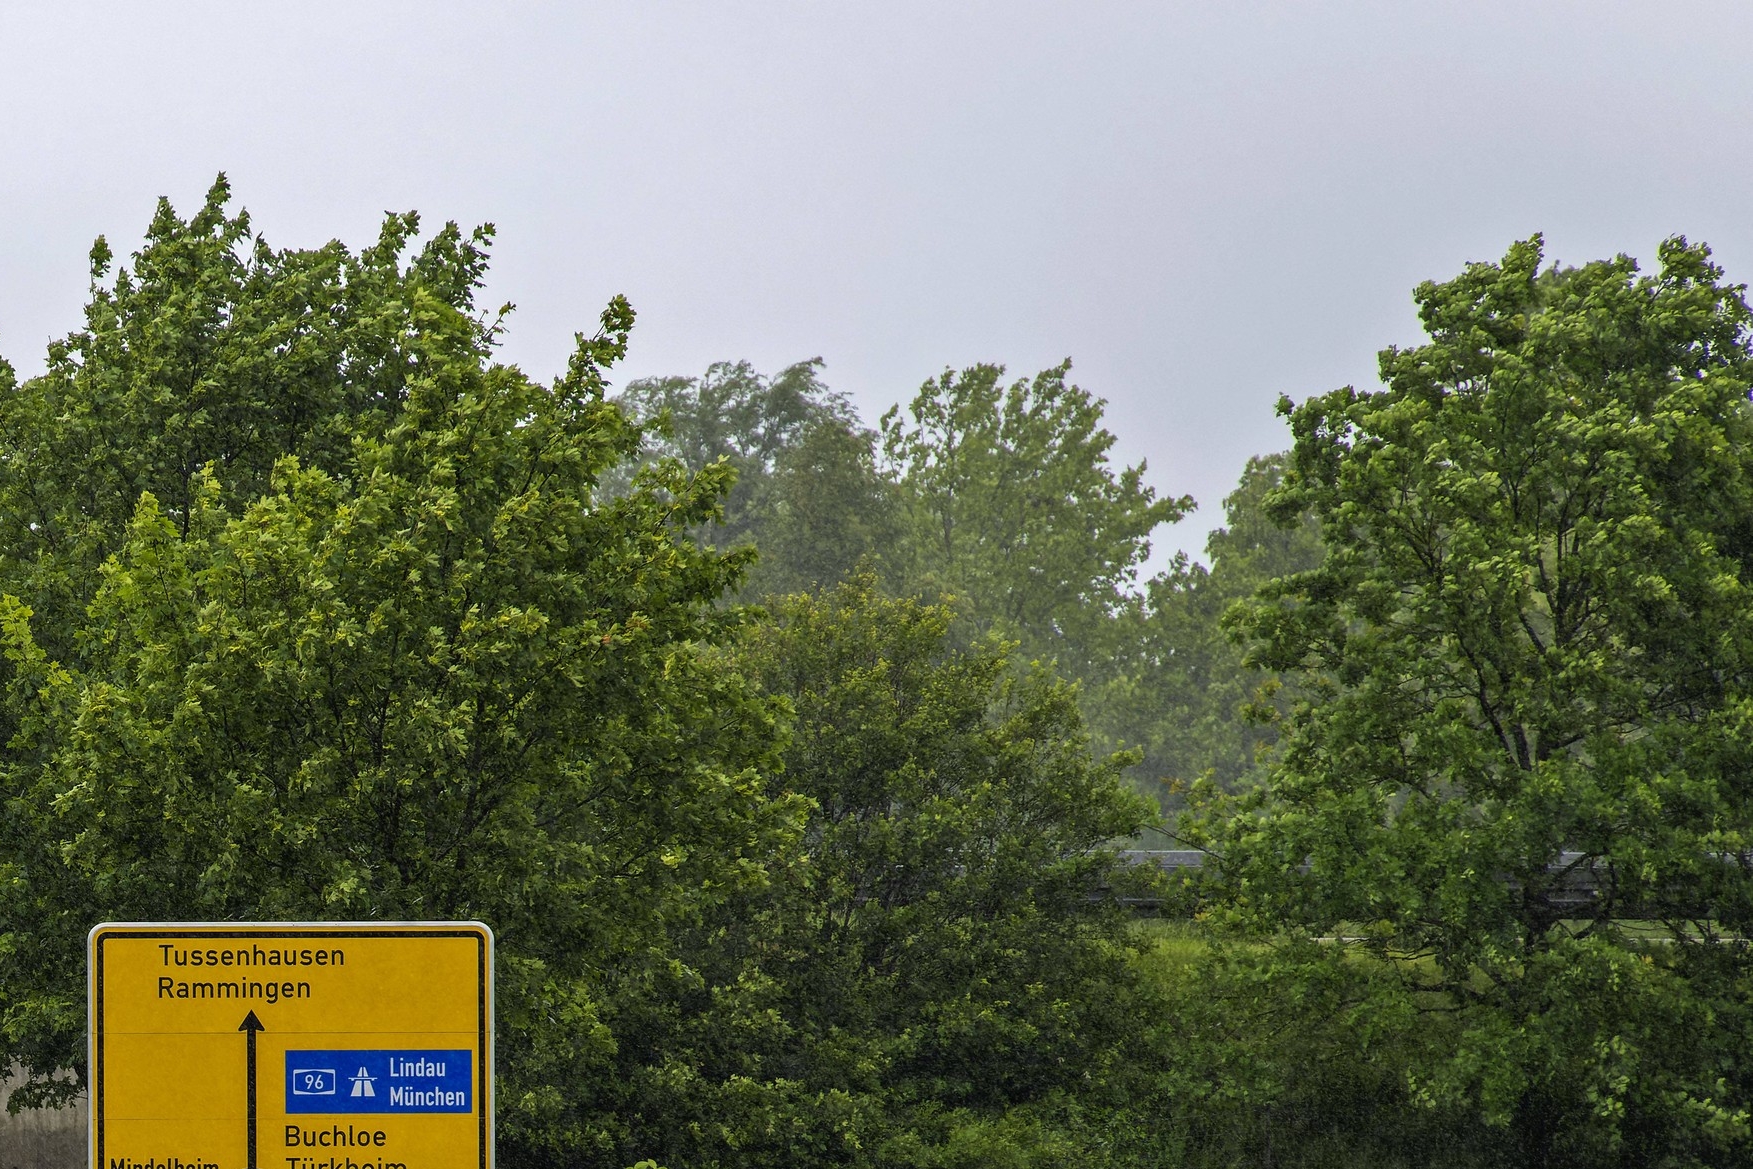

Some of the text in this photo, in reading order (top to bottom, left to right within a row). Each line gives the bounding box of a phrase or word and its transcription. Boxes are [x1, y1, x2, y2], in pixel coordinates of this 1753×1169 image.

[158, 943, 345, 967] Tussenhausen
[158, 976, 311, 1004] Rammingen
[389, 1057, 446, 1077] Lindau
[303, 1073, 325, 1091] 96
[389, 1086, 465, 1107] München
[284, 1125, 387, 1147] Buchloe
